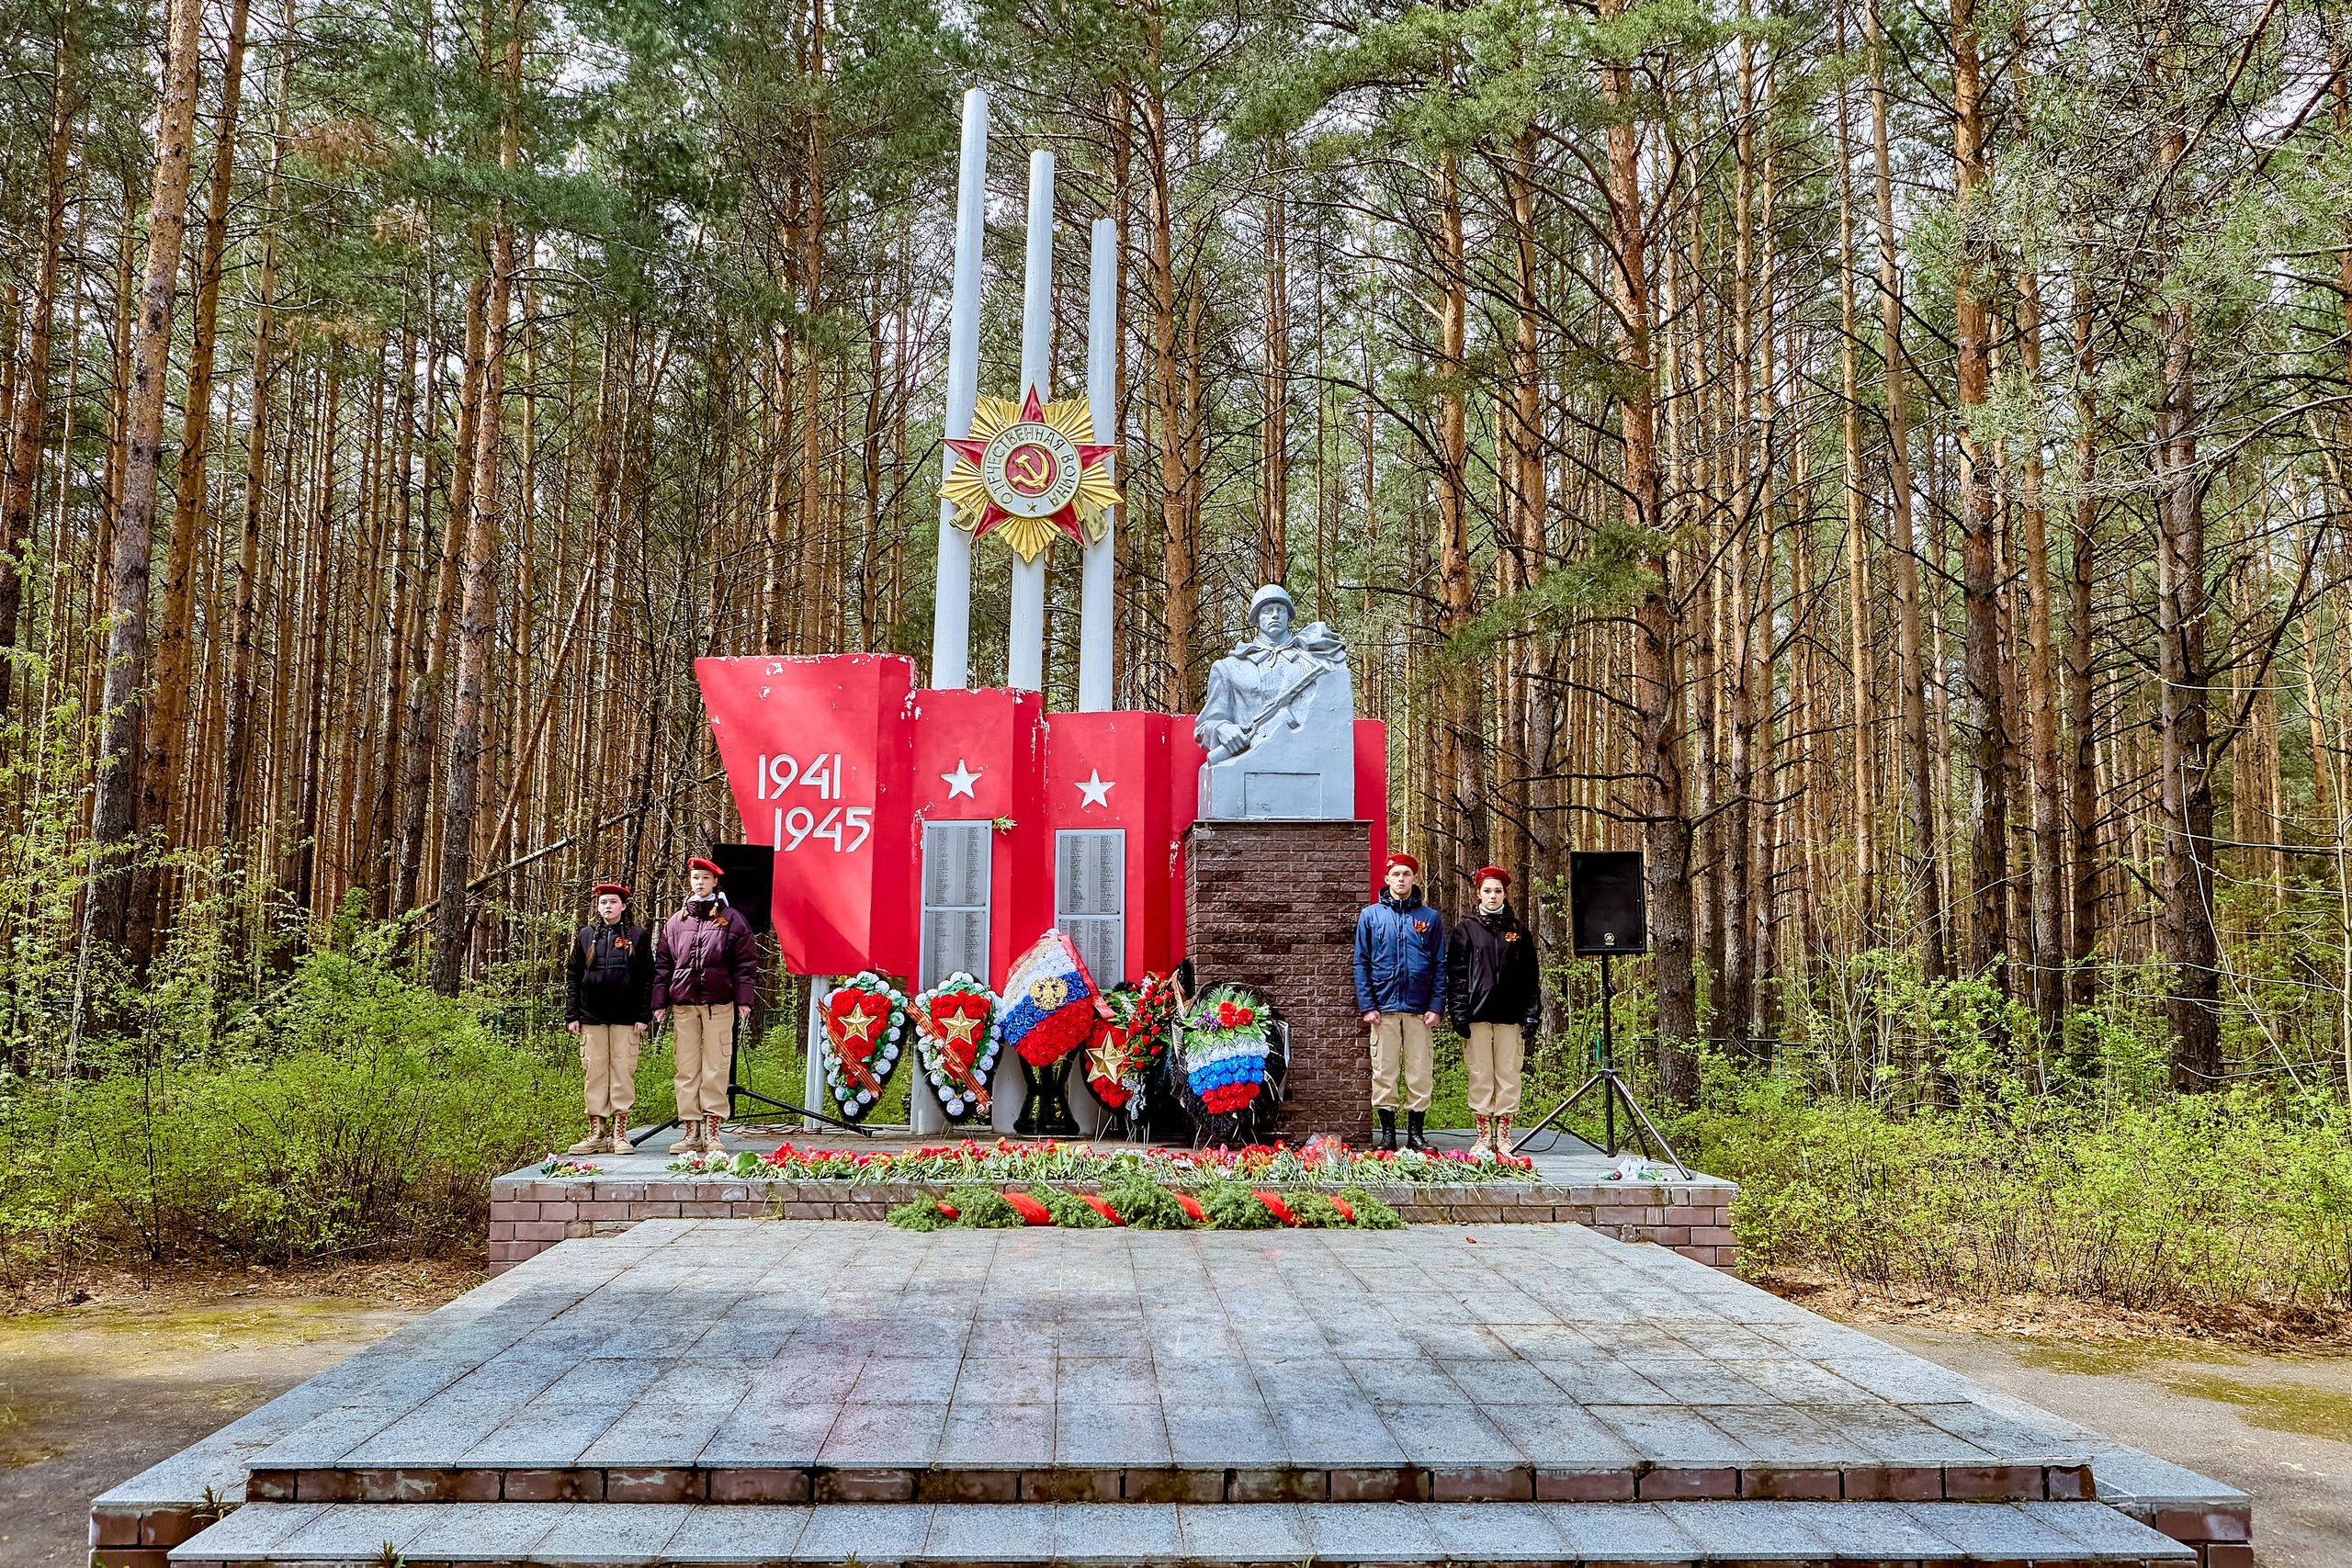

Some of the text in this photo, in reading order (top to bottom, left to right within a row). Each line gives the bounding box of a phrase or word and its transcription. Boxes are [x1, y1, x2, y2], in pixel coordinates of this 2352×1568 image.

[988, 428, 1065, 503] ОТЕЧЕСТВЕННАЯ
[758, 753, 842, 799] 1941
[774, 807, 872, 852] 1945
